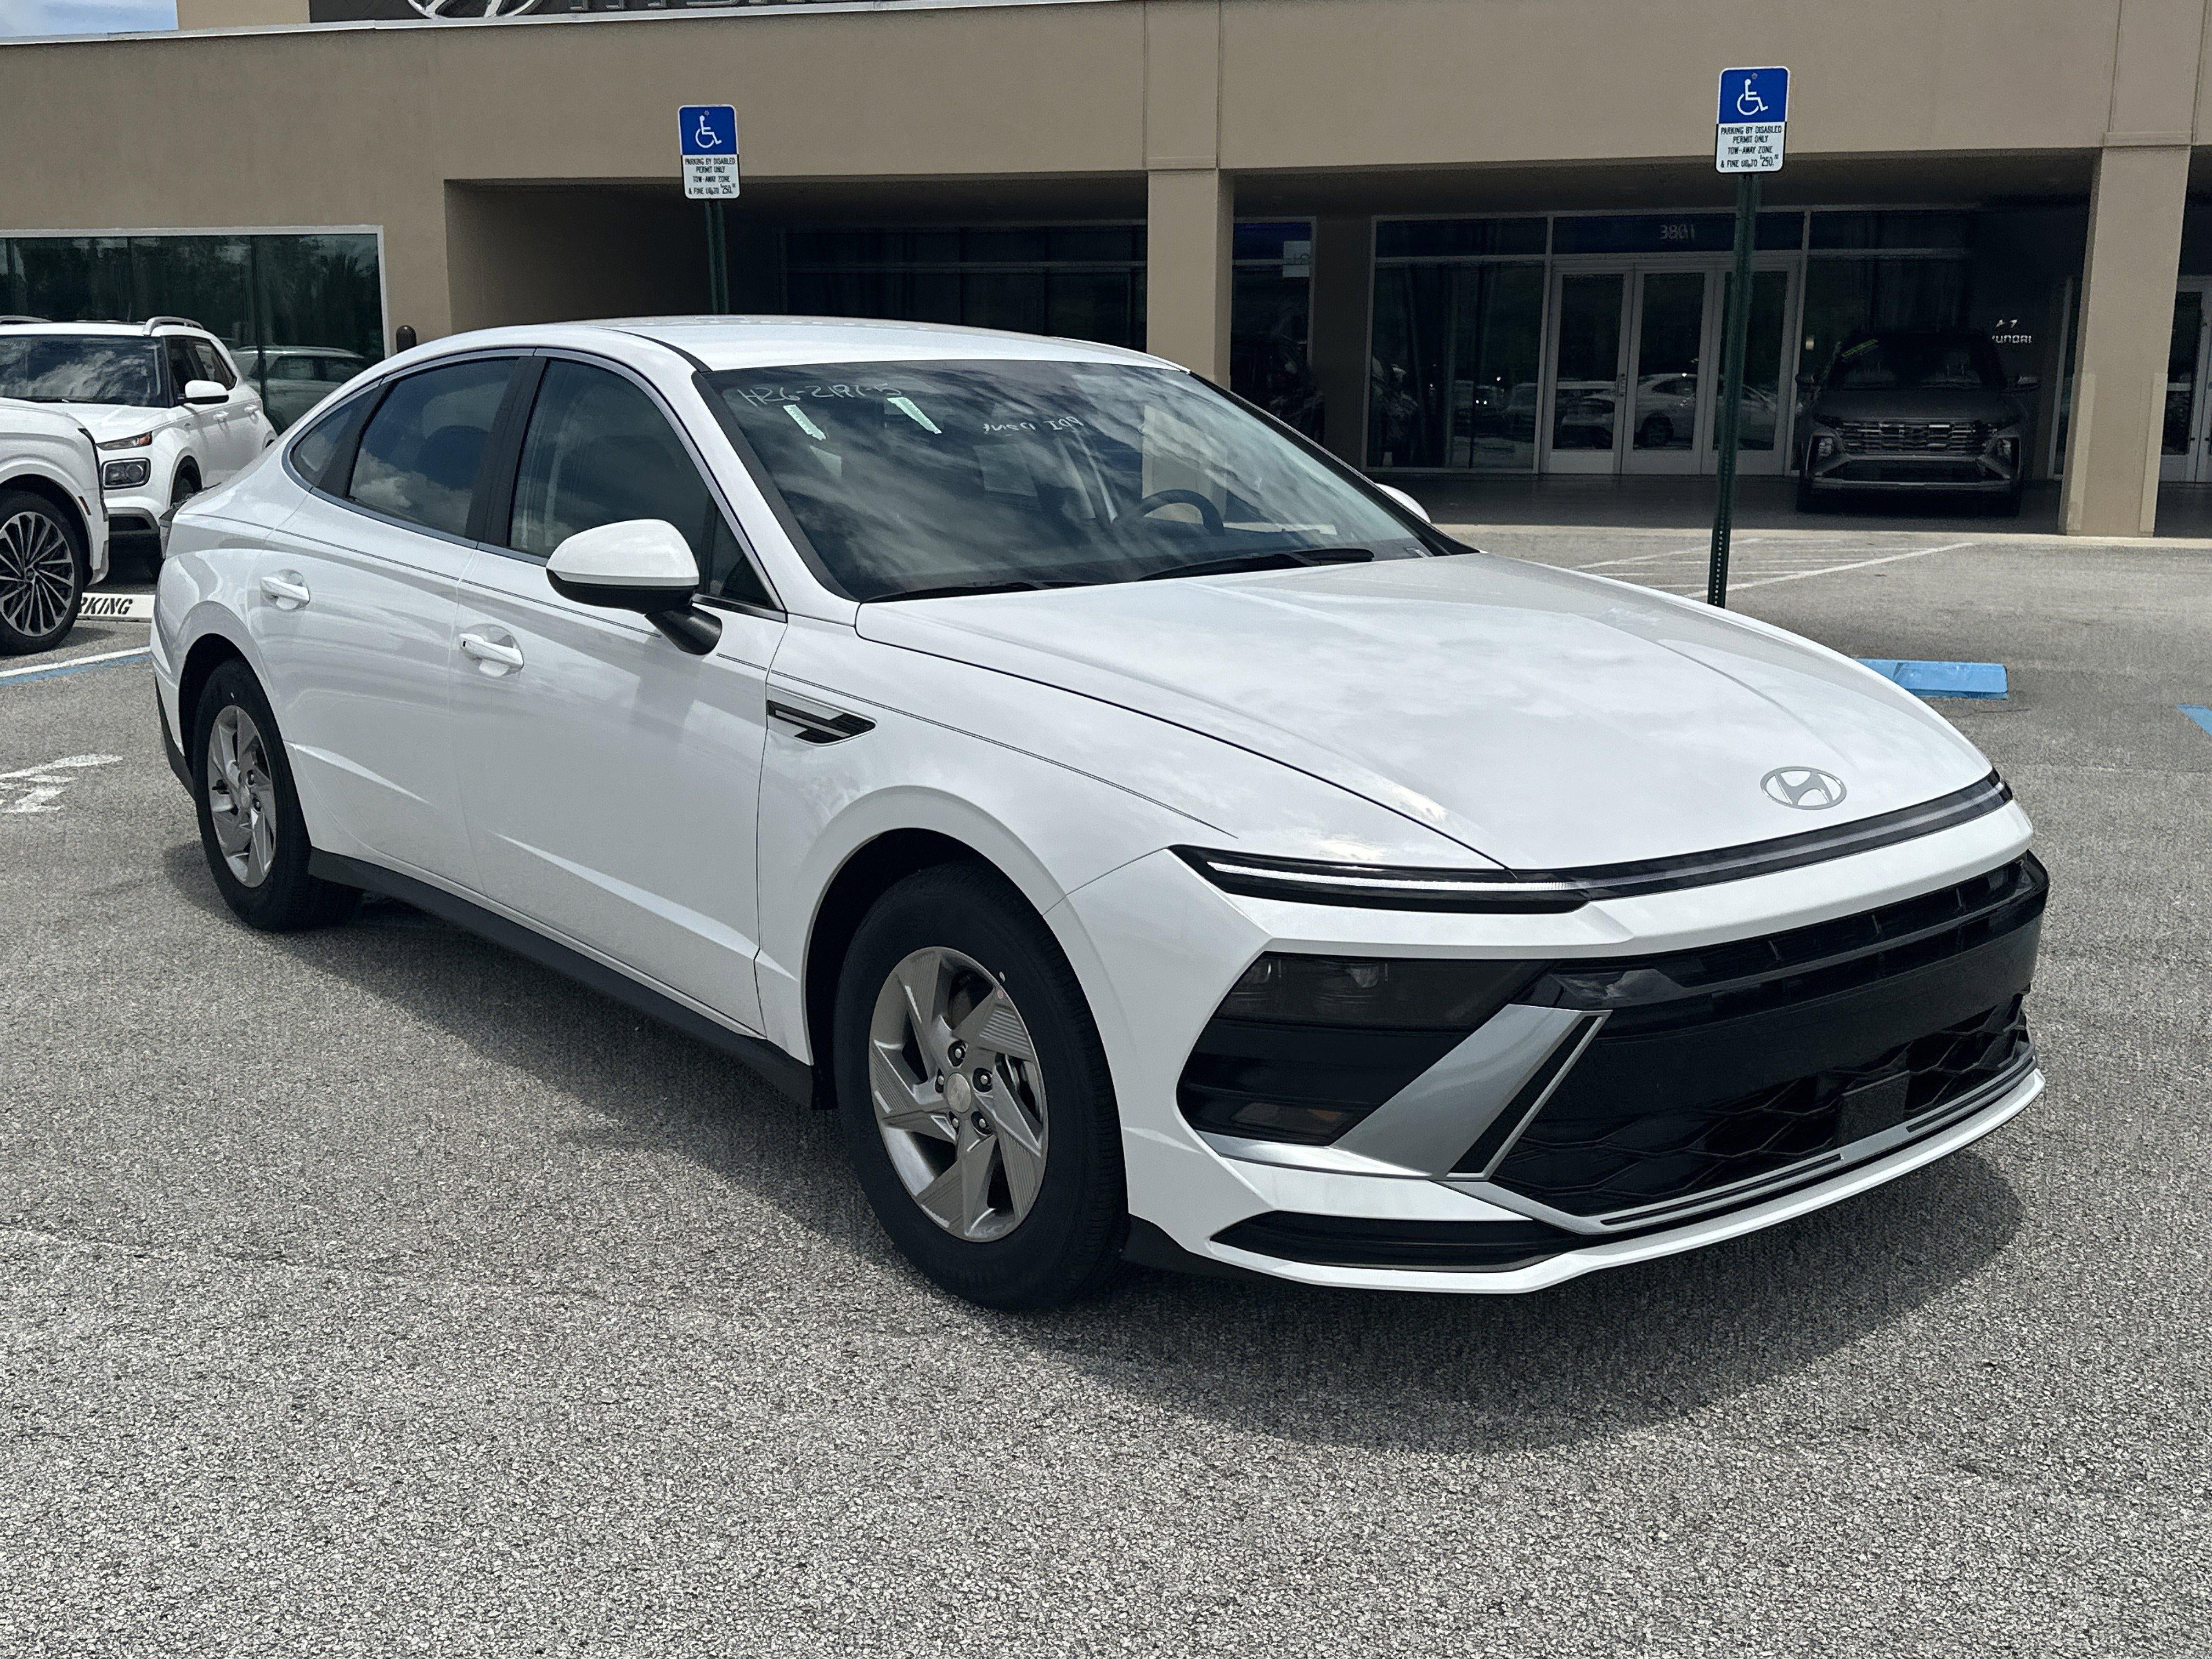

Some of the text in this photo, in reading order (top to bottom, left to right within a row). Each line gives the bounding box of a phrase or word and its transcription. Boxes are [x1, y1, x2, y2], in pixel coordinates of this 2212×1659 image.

[1720, 127, 1743, 135] PARKING
[1755, 126, 1782, 134] DISABLED
[1754, 135, 1769, 143] ONLY
[1758, 145, 1773, 154] ZONE
[1727, 160, 1739, 168] FINE
[1658, 224, 1695, 240] 3801
